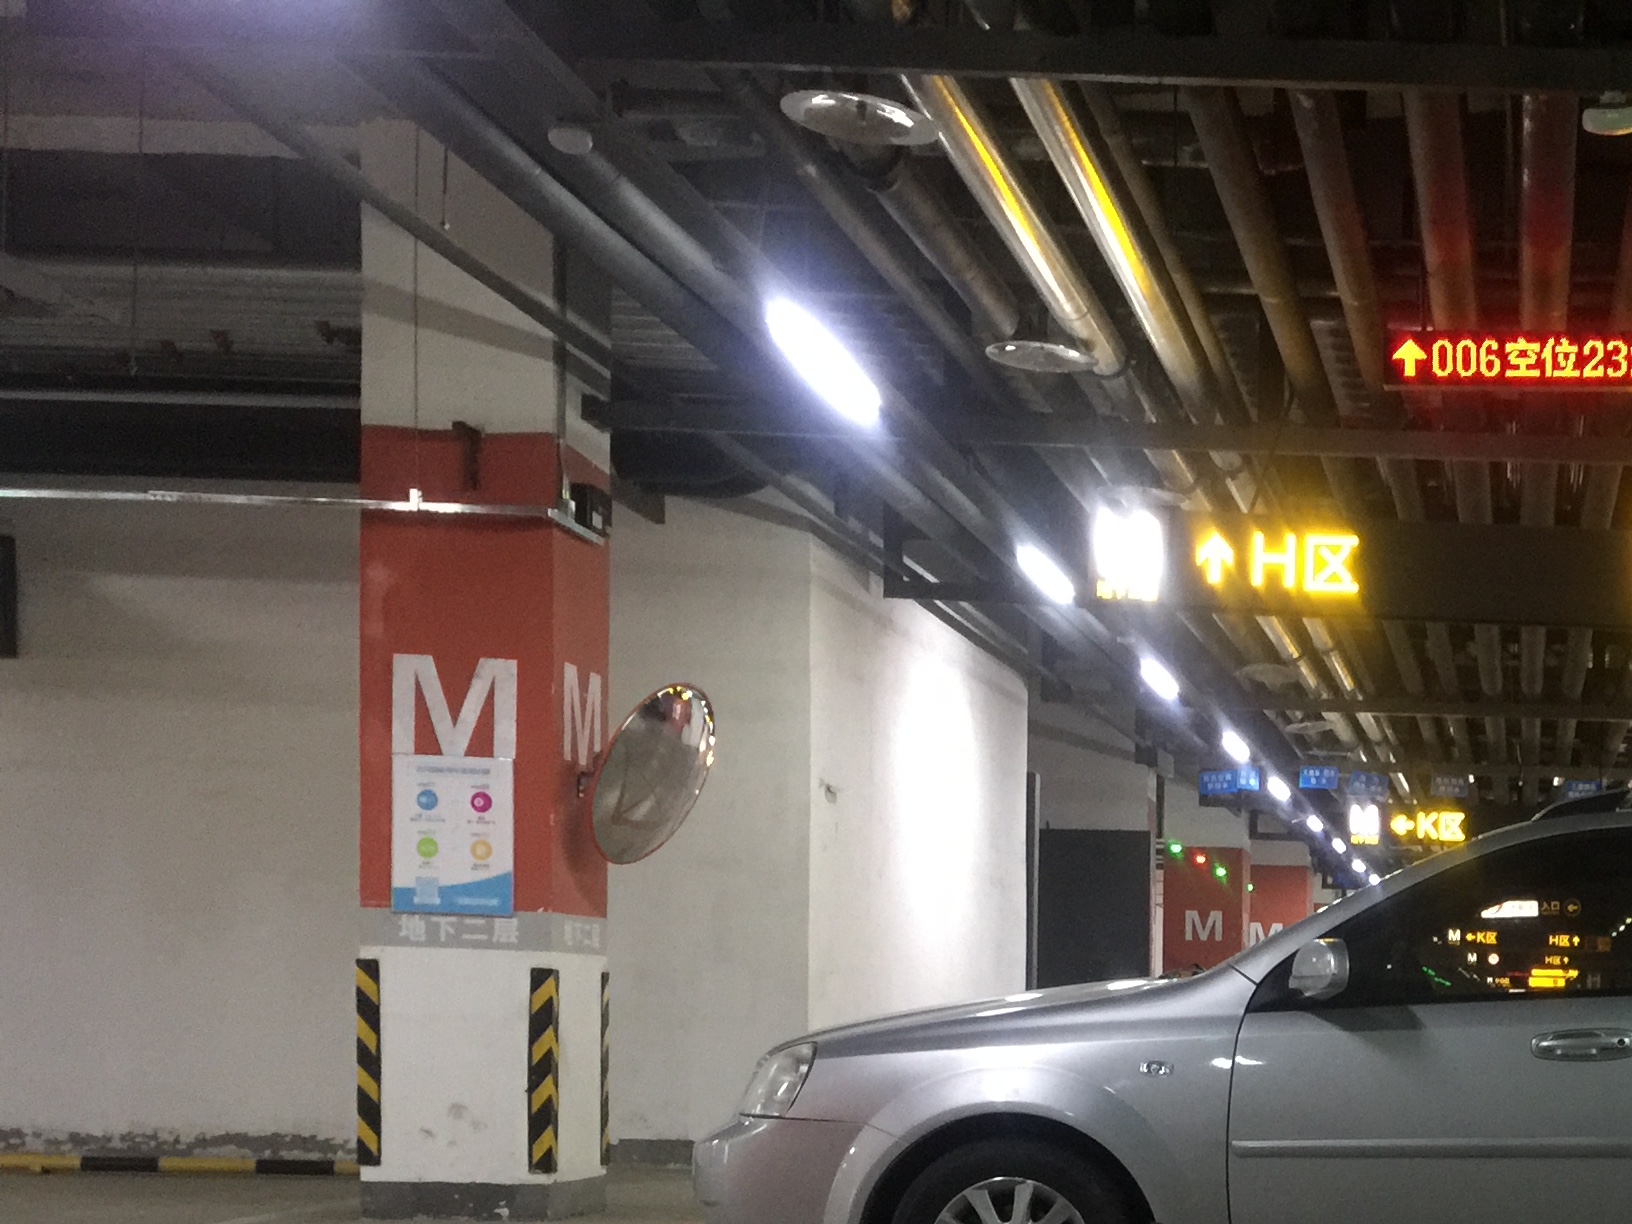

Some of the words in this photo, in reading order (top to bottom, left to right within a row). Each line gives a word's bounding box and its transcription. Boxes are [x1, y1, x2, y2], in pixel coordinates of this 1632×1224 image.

[1250, 531, 1360, 595] H区
[392, 653, 517, 759] M
[563, 661, 602, 765] M
[1416, 811, 1466, 842] K区
[399, 915, 519, 944] 地下二层
[1185, 910, 1223, 941] M
[1448, 928, 1461, 941] M
[1477, 931, 1498, 944] K区
[1549, 934, 1571, 947] H区
